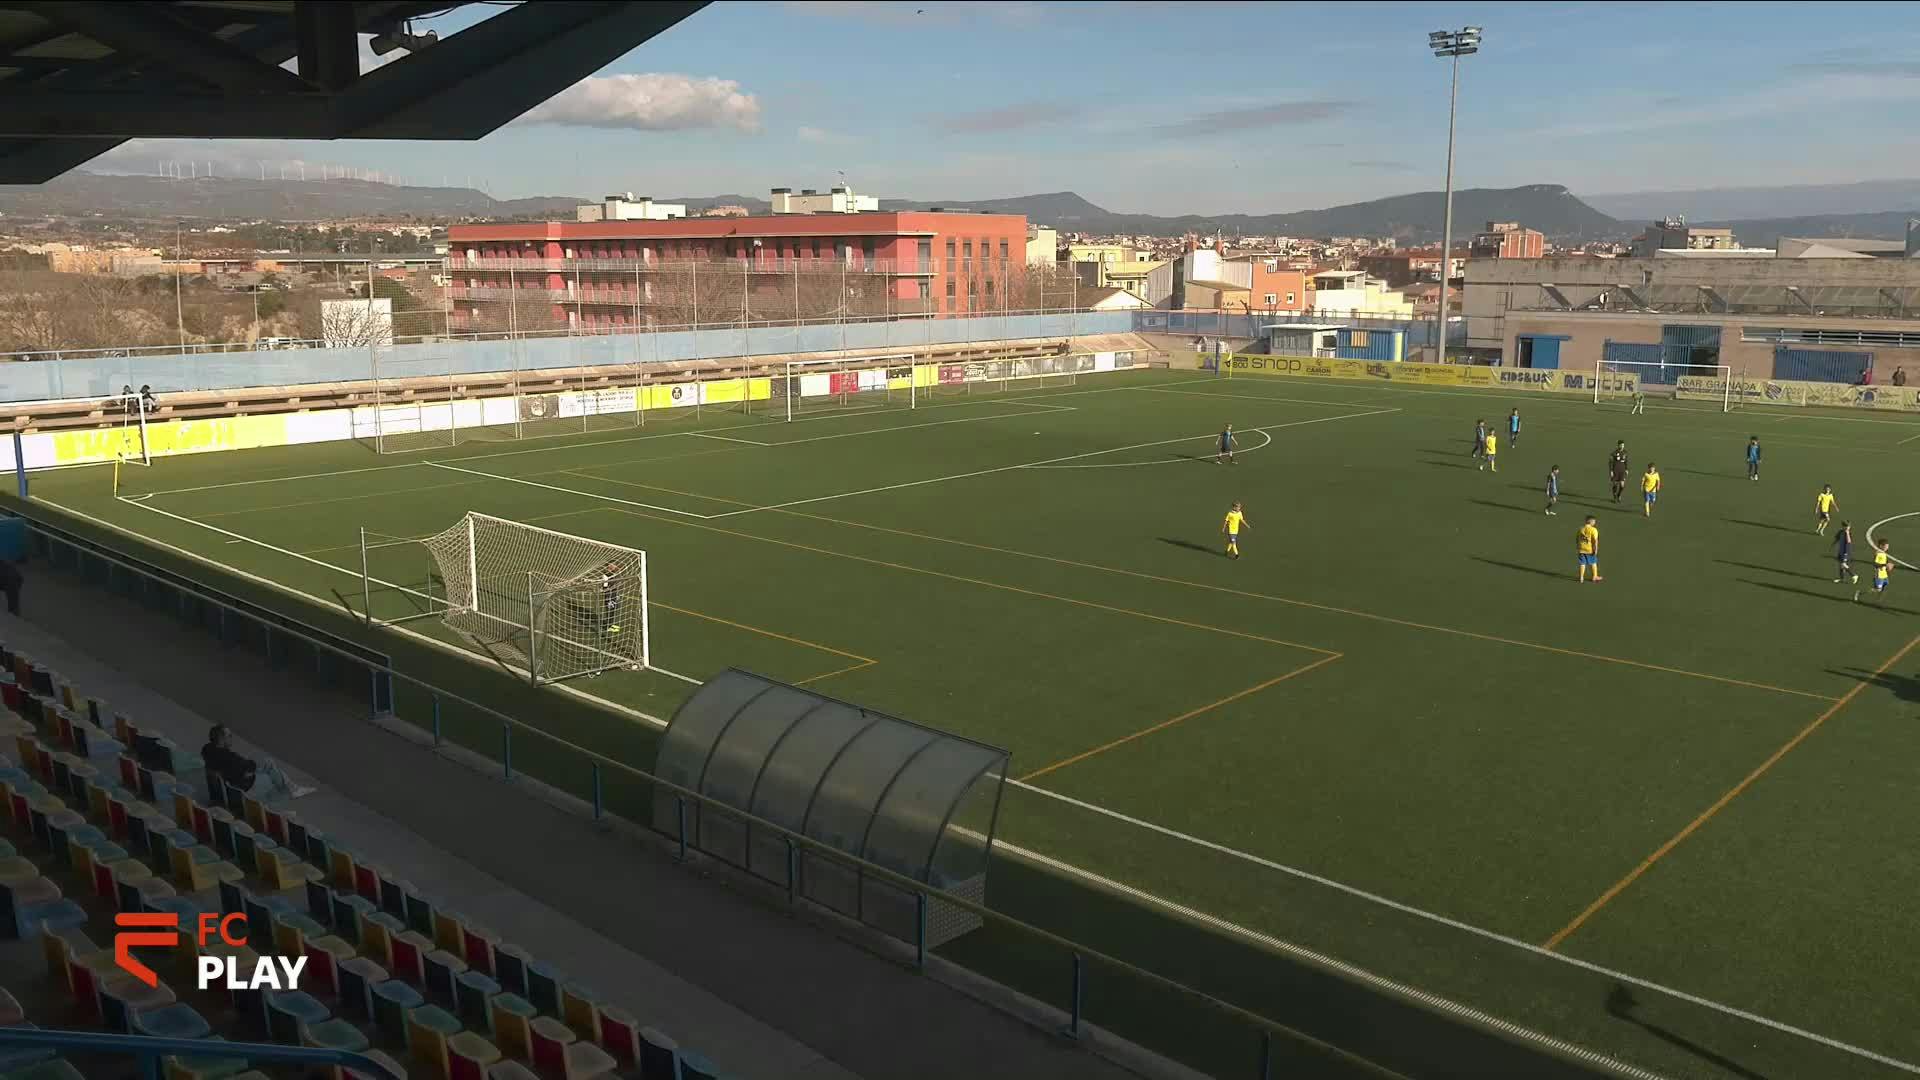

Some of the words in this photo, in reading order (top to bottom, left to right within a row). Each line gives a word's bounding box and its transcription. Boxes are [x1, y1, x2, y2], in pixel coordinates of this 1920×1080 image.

[1251, 357, 1301, 374] snop
[1682, 378, 1702, 388] BAR
[1706, 380, 1757, 391] GRANADA
